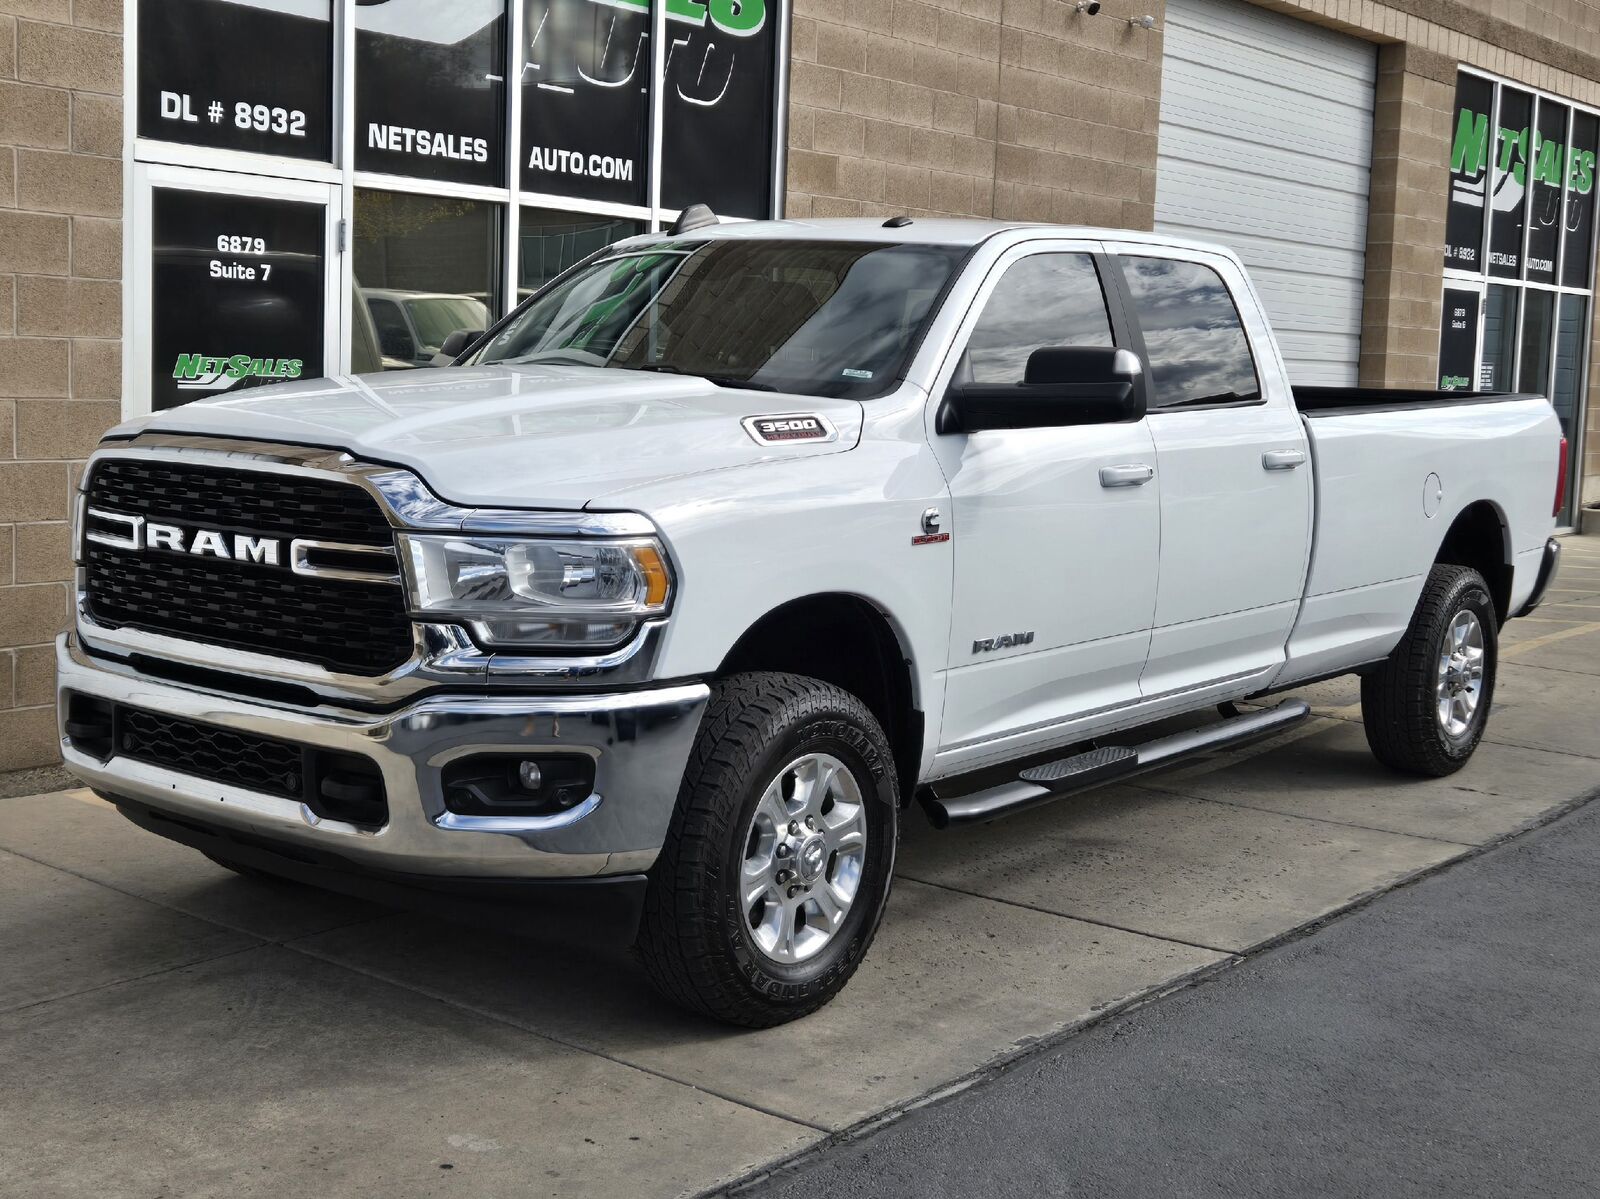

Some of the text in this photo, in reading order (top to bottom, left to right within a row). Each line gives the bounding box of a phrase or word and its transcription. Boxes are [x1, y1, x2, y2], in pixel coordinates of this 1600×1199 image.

[160, 90, 306, 137] DL # 8932
[368, 123, 633, 181] NETSALES AUTO.COM
[217, 235, 265, 255] 6879
[1458, 247, 1475, 260] 8932
[1488, 252, 1517, 266] NETSALES
[209, 260, 272, 281] Suite 7
[760, 420, 817, 432] 3500
[146, 522, 280, 566] RAM
[972, 631, 1035, 654] RAM
